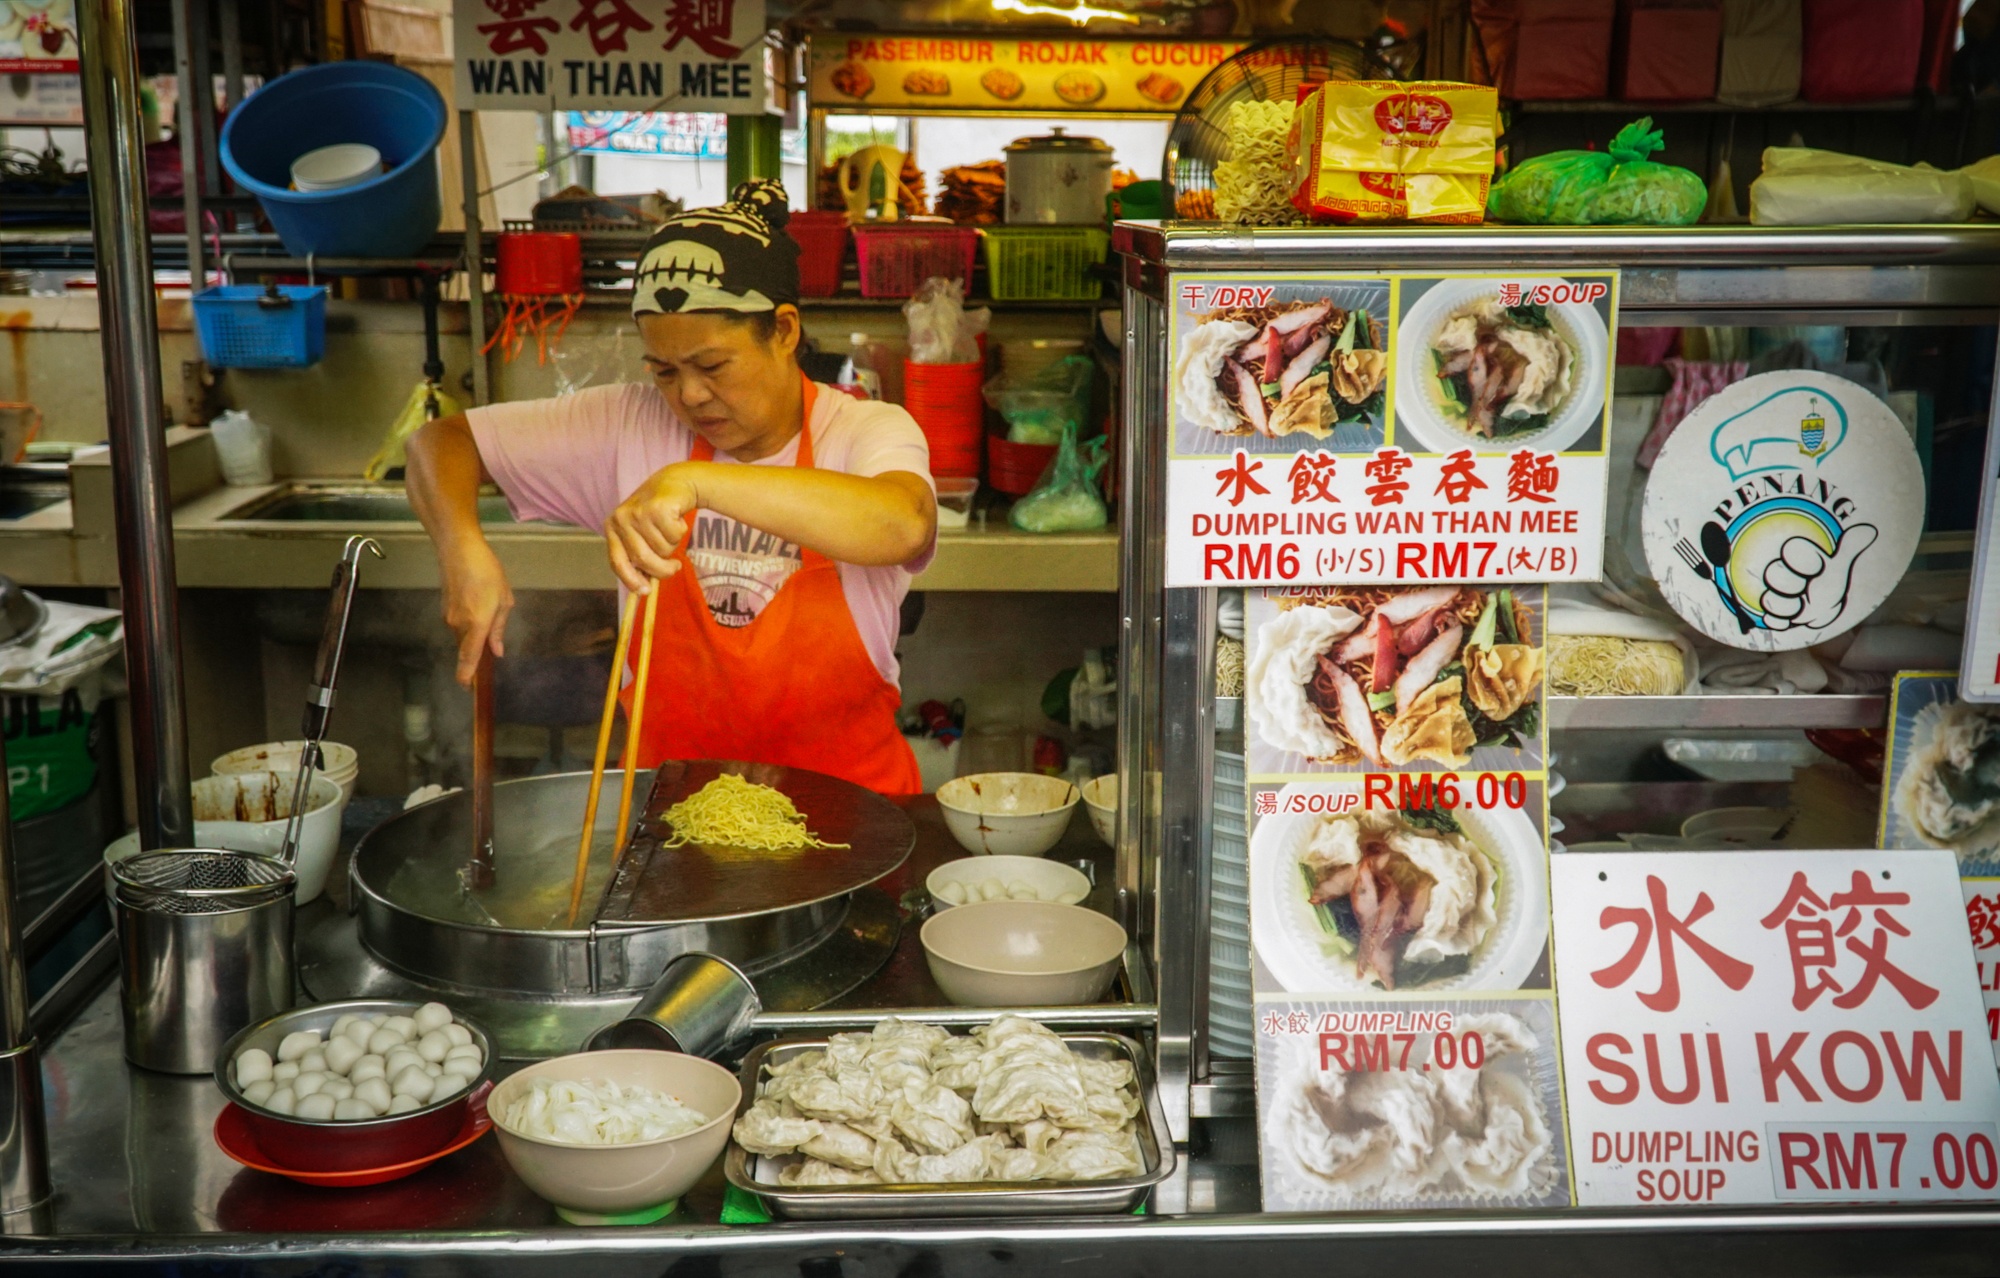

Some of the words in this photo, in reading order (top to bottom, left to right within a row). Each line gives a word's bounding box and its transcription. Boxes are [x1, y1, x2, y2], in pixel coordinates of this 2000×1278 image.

[846, 39, 994, 63] PASEMBUR
[1018, 41, 1108, 66] ROJAK
[1131, 43, 1225, 67] CUCUR
[469, 59, 546, 95] WAN
[563, 60, 663, 97] THAN
[680, 62, 752, 99] MEE
[1209, 287, 1273, 308] /DRY
[1498, 284, 1521, 306] 湯
[1525, 284, 1606, 306] /SOUP
[1712, 473, 1857, 523] PENANG
[1192, 512, 1347, 537] DUMPLING
[1355, 512, 1424, 535] WAN
[1432, 511, 1515, 534] THAN
[1520, 511, 1578, 533] MEE
[1204, 542, 1300, 581] RM6
[712, 611, 751, 627] ASUAL
[1256, 792, 1278, 815] 湯
[1284, 794, 1359, 814] /SOUP
[1364, 771, 1527, 811] RM6.00
[1590, 870, 1940, 1012] 水餃
[1263, 1011, 1310, 1035] 水餃
[1315, 1012, 1453, 1033] /DUMPLING
[1318, 1030, 1485, 1073] RM7.00
[1585, 1032, 1730, 1105] SUI
[1755, 1030, 1963, 1103] KOW
[1591, 1130, 1760, 1163] DUMPLING
[1778, 1131, 1999, 1191] RM7.00
[1636, 1168, 1726, 1201] SOUP
